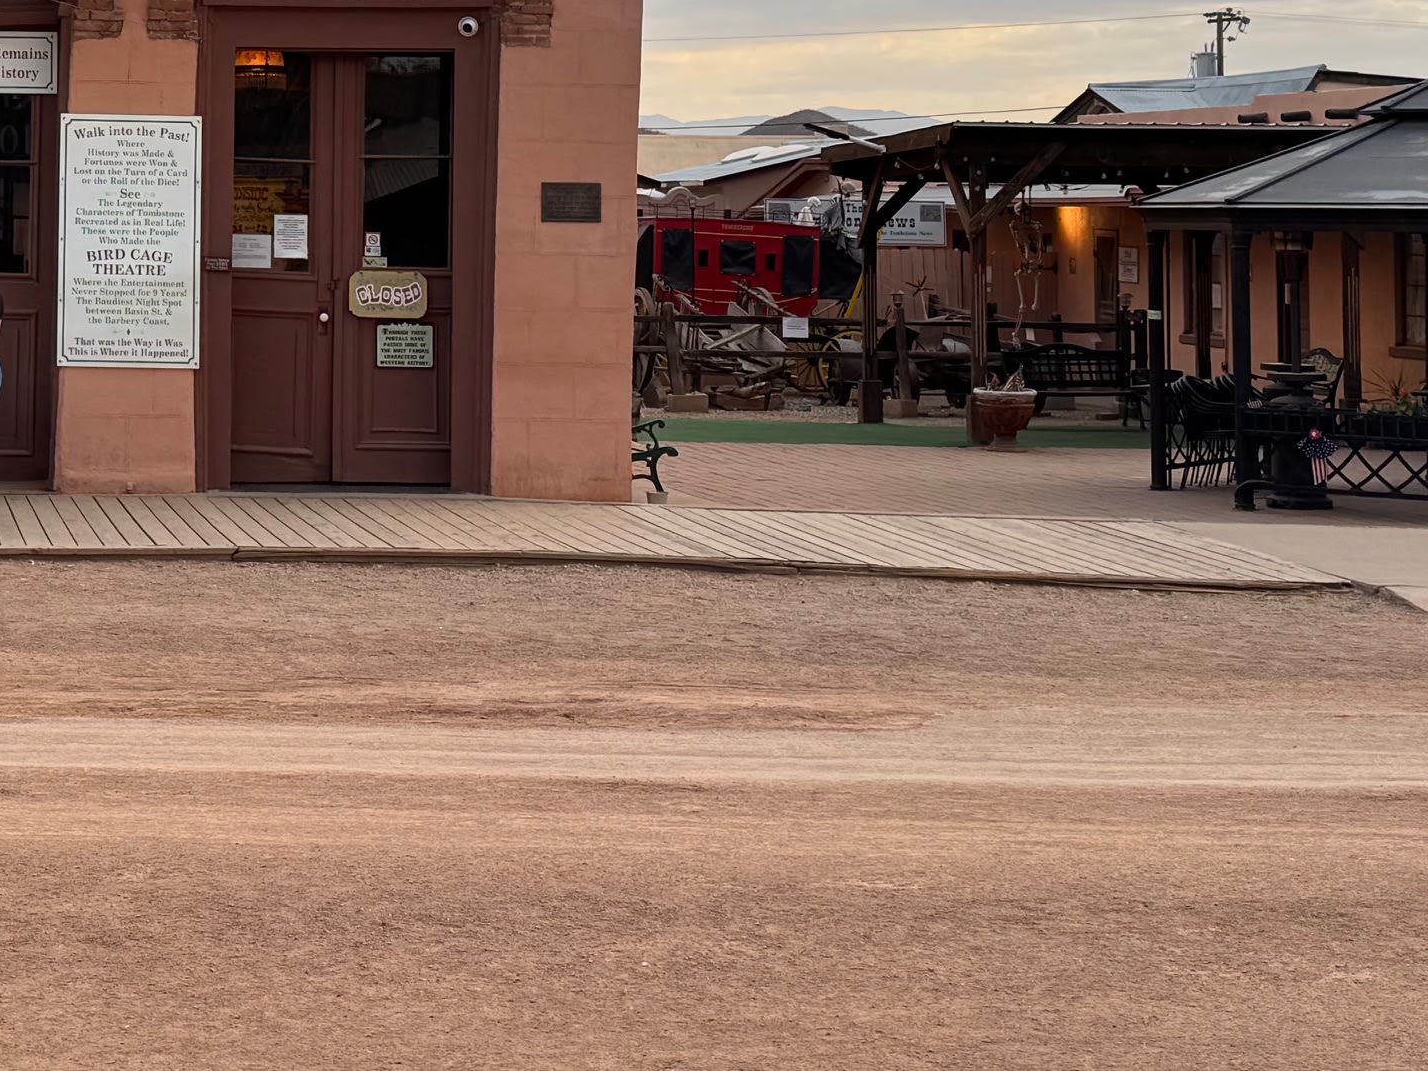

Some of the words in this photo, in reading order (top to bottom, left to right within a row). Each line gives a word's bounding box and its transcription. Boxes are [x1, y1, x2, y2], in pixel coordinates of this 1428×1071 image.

[74, 127, 105, 139] Walk
[109, 126, 132, 136] into
[137, 126, 156, 137] the
[159, 128, 190, 142] Past!
[88, 148, 120, 157] History
[142, 149, 165, 157] Made
[149, 159, 168, 167] Won
[157, 178, 179, 186] Dice!
[120, 188, 141, 199] See
[117, 199, 163, 208] Legendary
[846, 203, 863, 213] The
[76, 208, 123, 216] Characters
[137, 209, 185, 218] Tombstone
[75, 218, 118, 226] Recreated
[167, 219, 186, 227] Life!
[883, 218, 915, 228] ews
[150, 229, 178, 238] People
[86, 249, 126, 262] BIRD
[130, 249, 173, 264] CAGE
[93, 264, 166, 276] THEATRE
[121, 279, 185, 287] Entertainment
[99, 288, 135, 297] Stopped
[356, 282, 422, 306] CLOSED
[136, 298, 160, 307] Night
[162, 299, 182, 307] Spot
[74, 337, 95, 345] That
[134, 339, 153, 348] Way
[68, 347, 88, 355] This
[141, 349, 189, 358] Happened!
